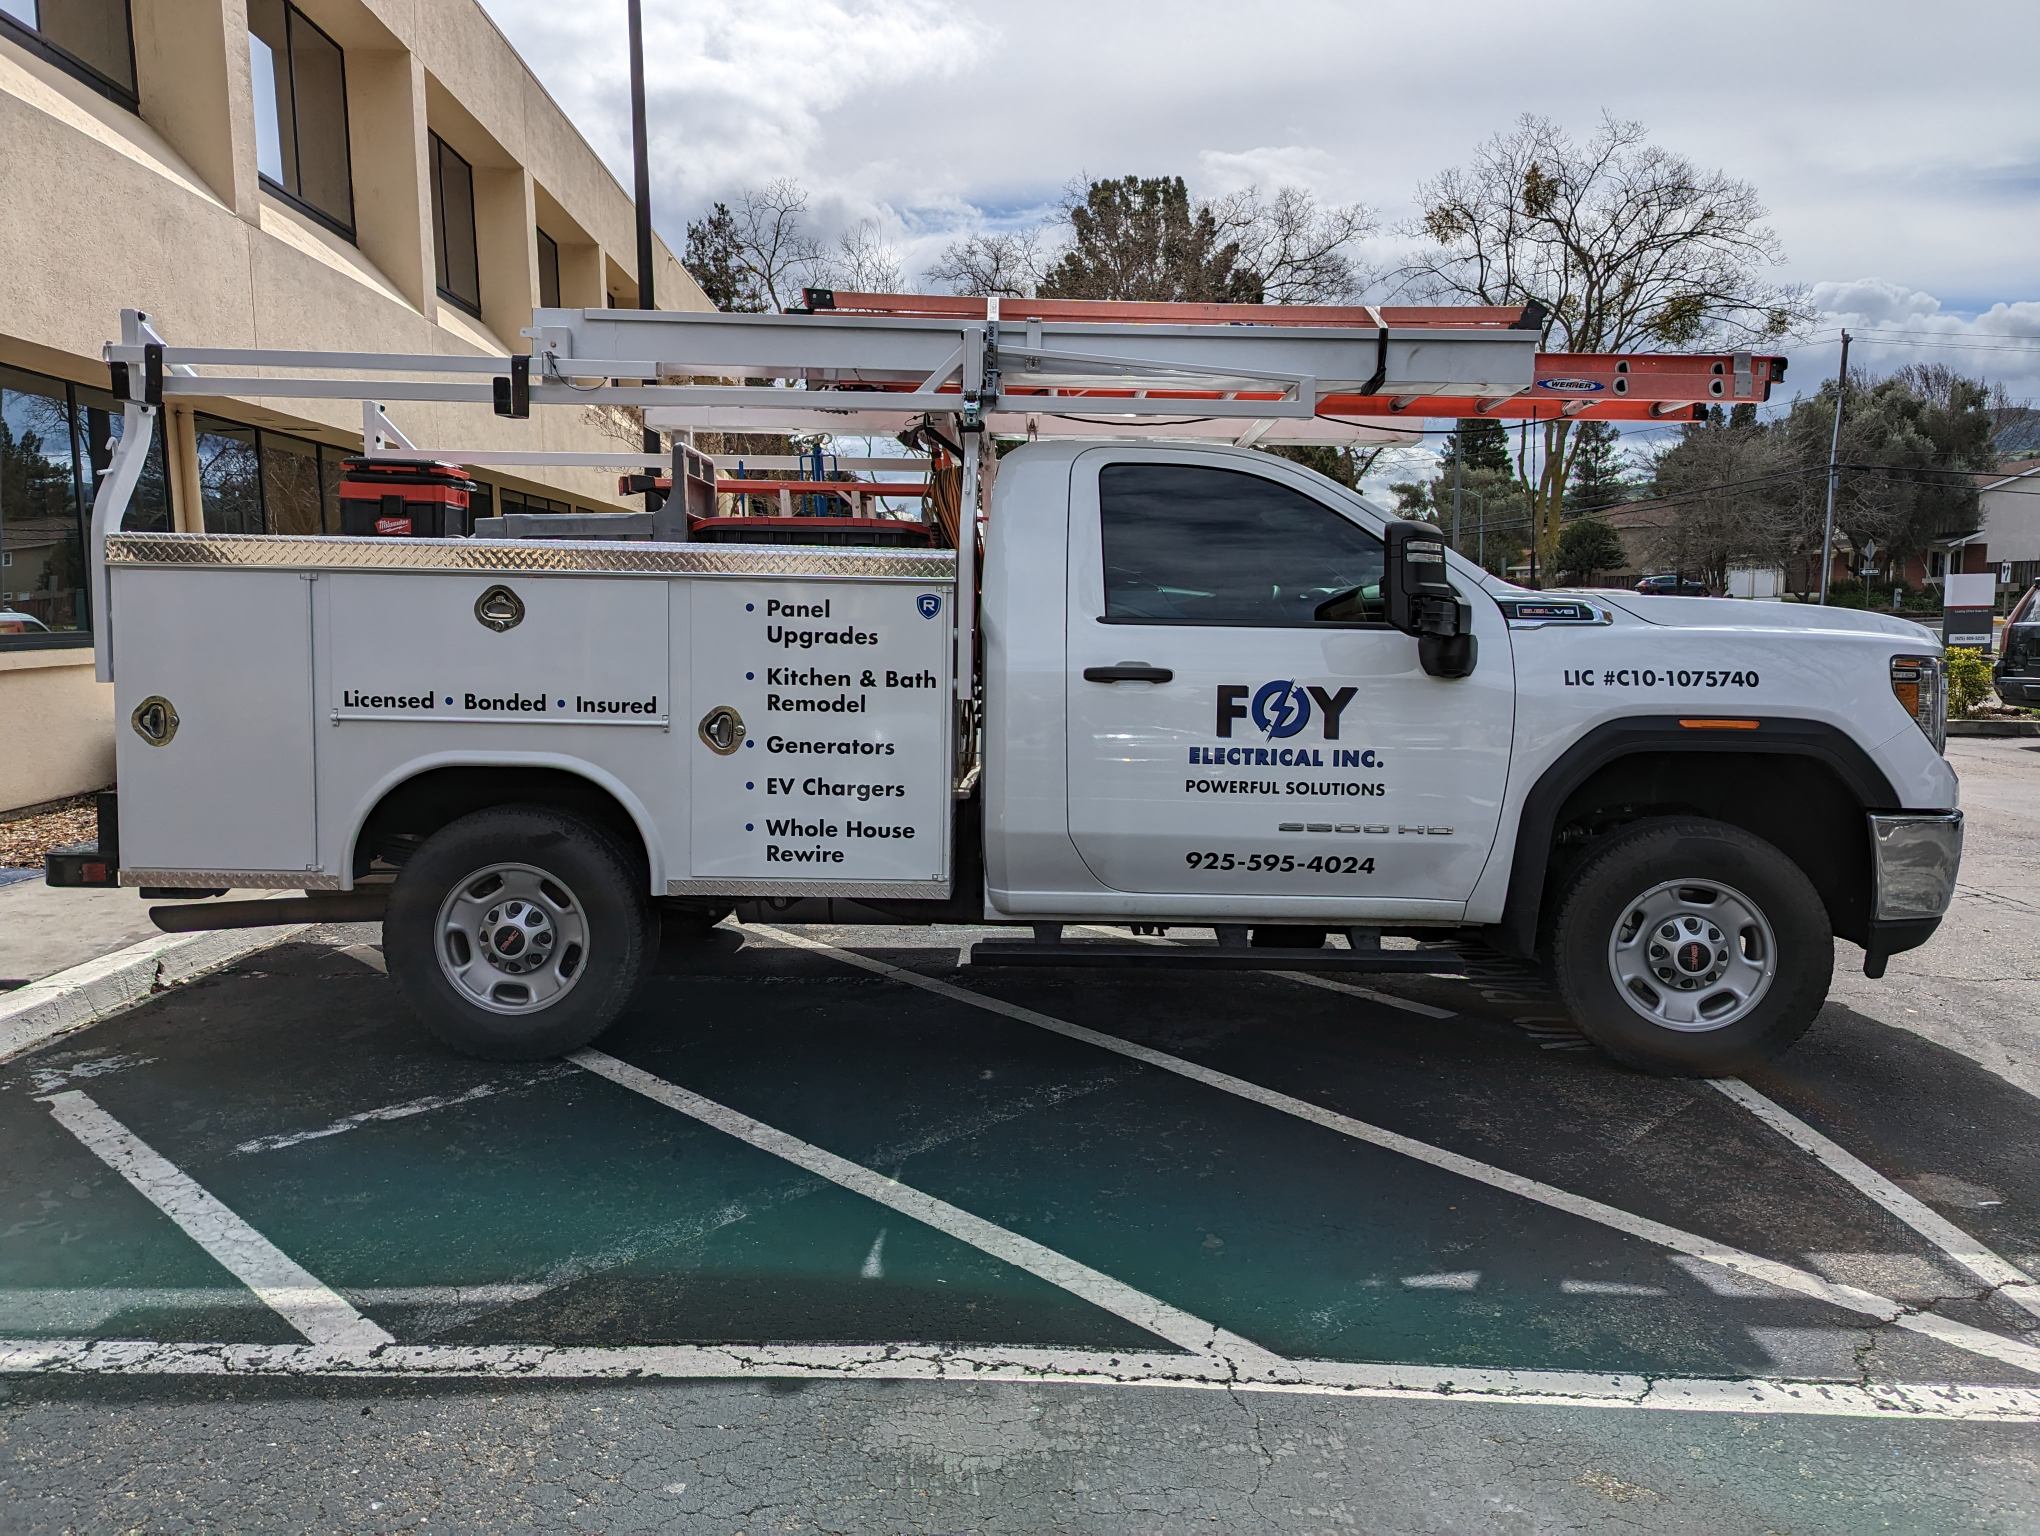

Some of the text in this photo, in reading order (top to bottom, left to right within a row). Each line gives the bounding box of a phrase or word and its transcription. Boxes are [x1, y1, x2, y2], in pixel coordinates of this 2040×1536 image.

[1551, 381, 1592, 389] WERNER
[767, 599, 830, 618] Panel
[923, 600, 935, 611] R
[767, 625, 879, 648] Upgrades
[767, 667, 937, 688] Kitchen & Bath
[1564, 670, 1760, 688] LIC #C10-1075740
[343, 690, 657, 714] Licensed Bonded Insured
[767, 694, 866, 713] Remodel
[1216, 678, 1359, 743] FOY
[766, 736, 895, 756] Generators
[1189, 746, 1384, 768] ELECTRICAL INC.
[767, 777, 905, 802] EV Chargers
[1186, 780, 1386, 796] POWERFUL SOLUTIONS
[766, 818, 916, 838] Whole House
[766, 844, 844, 862] Rewire
[1186, 852, 1376, 874] 925-595-4024
